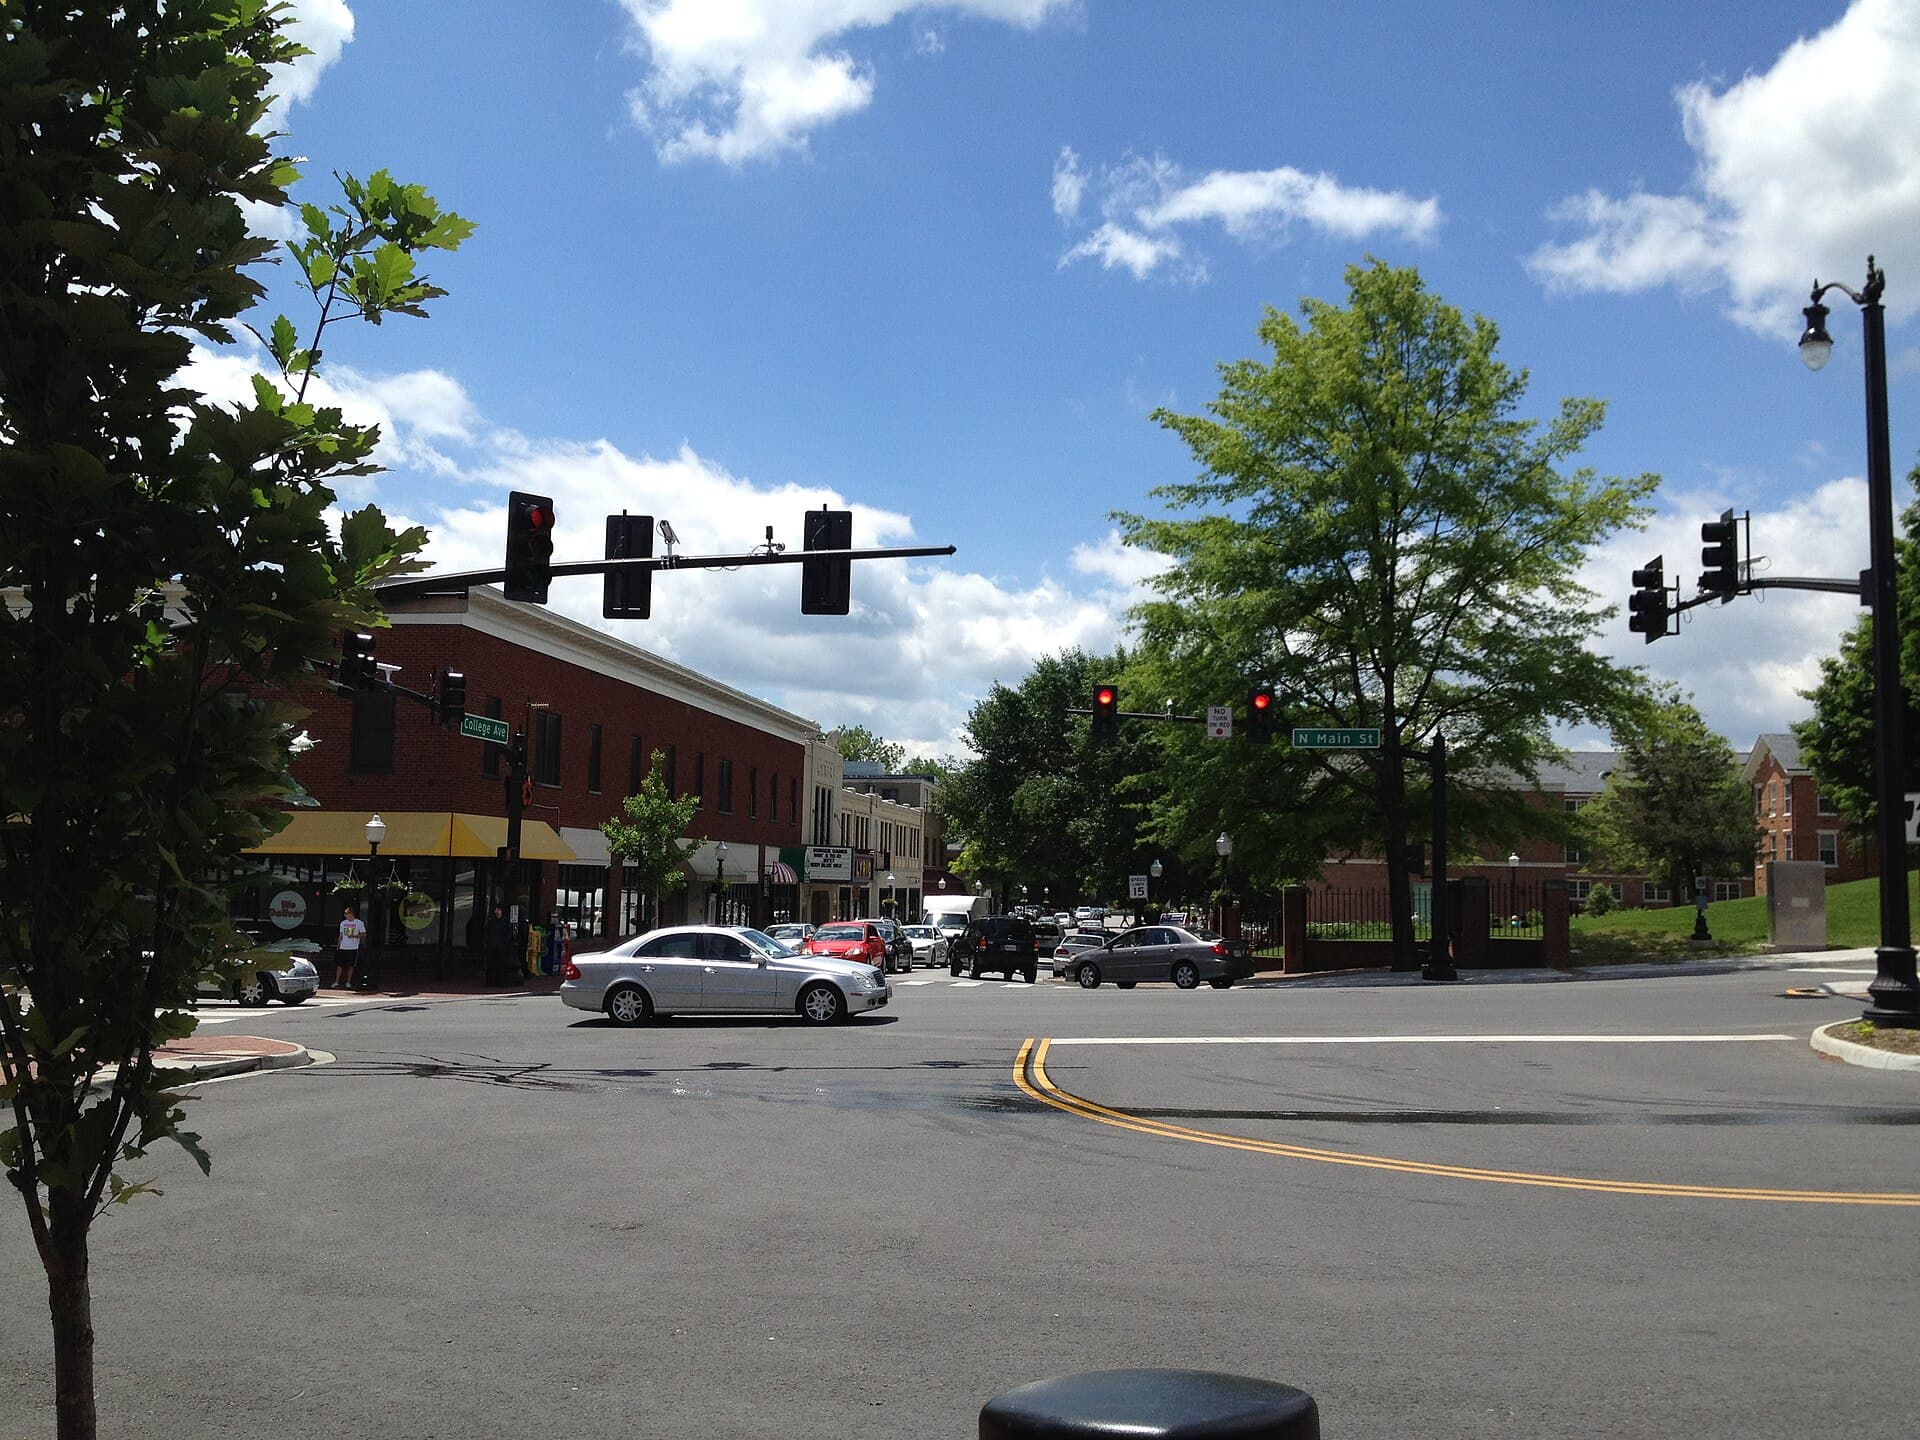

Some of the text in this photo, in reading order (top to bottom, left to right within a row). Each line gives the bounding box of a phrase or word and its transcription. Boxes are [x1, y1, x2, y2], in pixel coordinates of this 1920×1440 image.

[464, 718, 506, 737] College Ave
[1299, 732, 1373, 744] N Main St
[1134, 887, 1145, 896] 15
